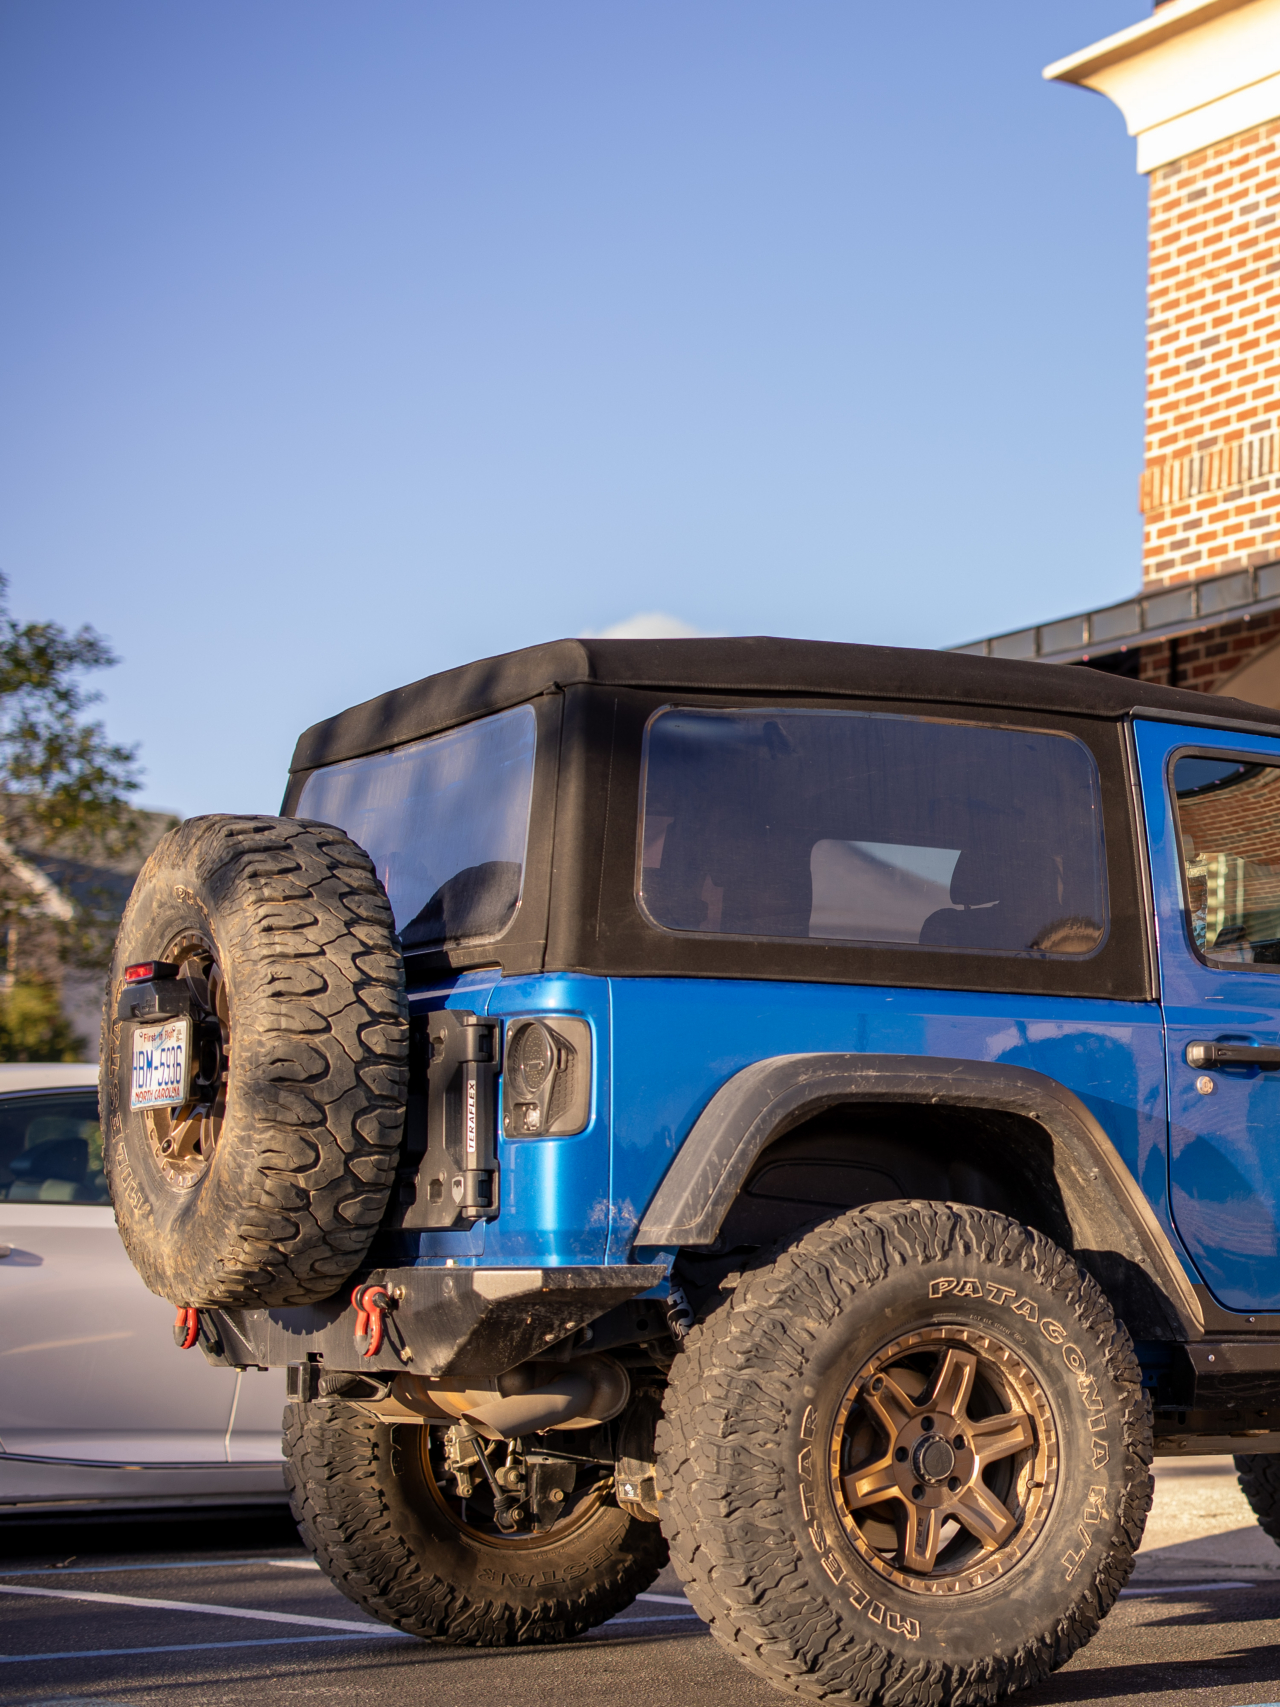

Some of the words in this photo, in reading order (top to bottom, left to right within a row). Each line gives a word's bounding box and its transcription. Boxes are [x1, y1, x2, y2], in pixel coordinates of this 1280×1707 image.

[132, 1045, 182, 1089] HBM-5936
[135, 1089, 154, 1103] NORTH
[468, 1083, 476, 1150] TERAFLEX
[929, 1277, 1110, 1470] PATAGONIA
[798, 1405, 921, 1641] MILESTAR
